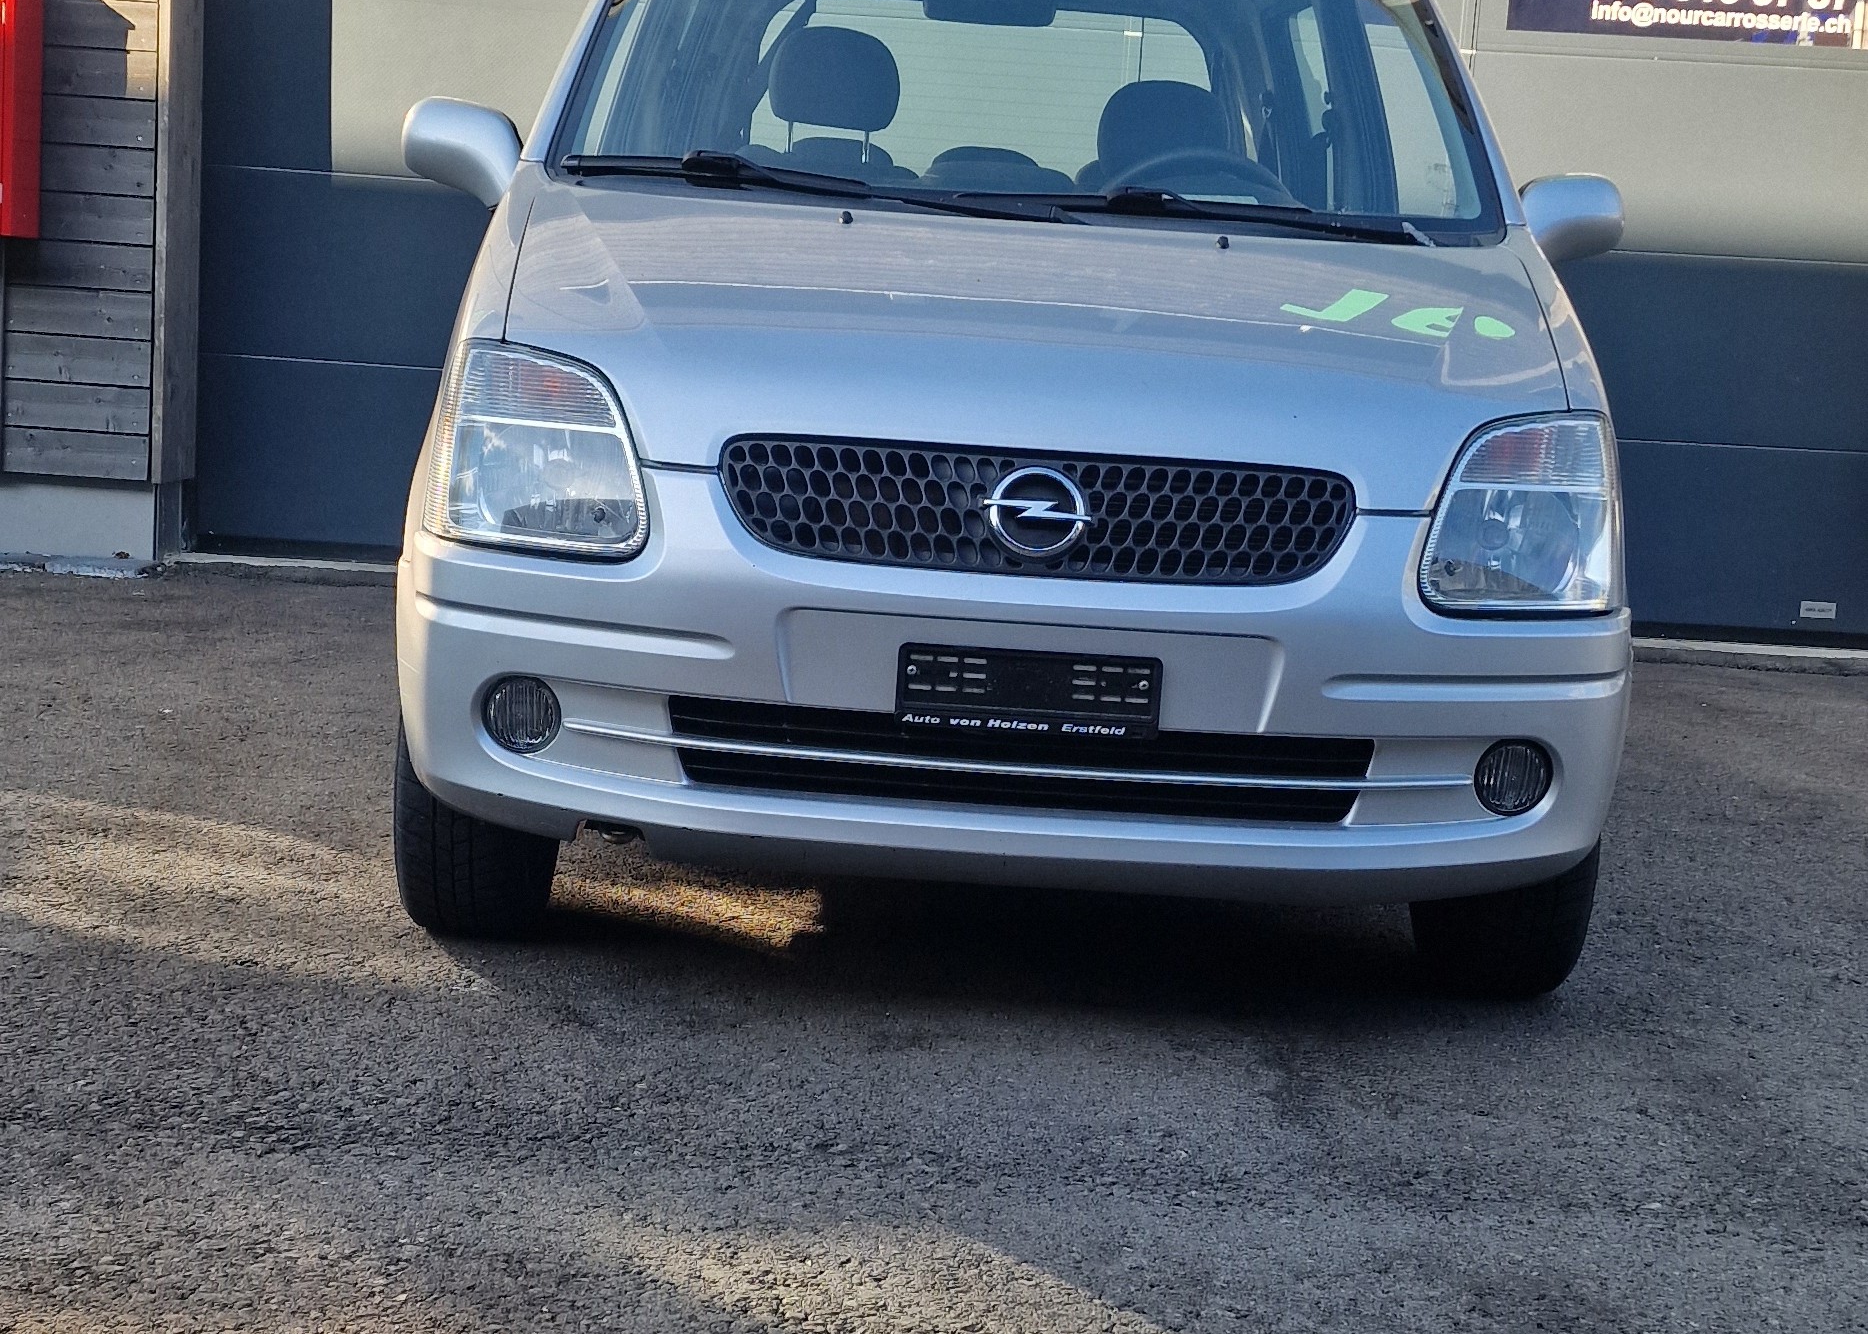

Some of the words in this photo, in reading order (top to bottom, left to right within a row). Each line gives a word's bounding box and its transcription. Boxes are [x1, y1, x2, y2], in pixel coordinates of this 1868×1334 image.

[1591, 0, 1851, 34] info@nourcarrosserie.ch
[902, 713, 940, 724] Auto
[950, 718, 981, 727] von
[987, 719, 1049, 731] Holzen
[1061, 724, 1126, 735] Erstfeld
